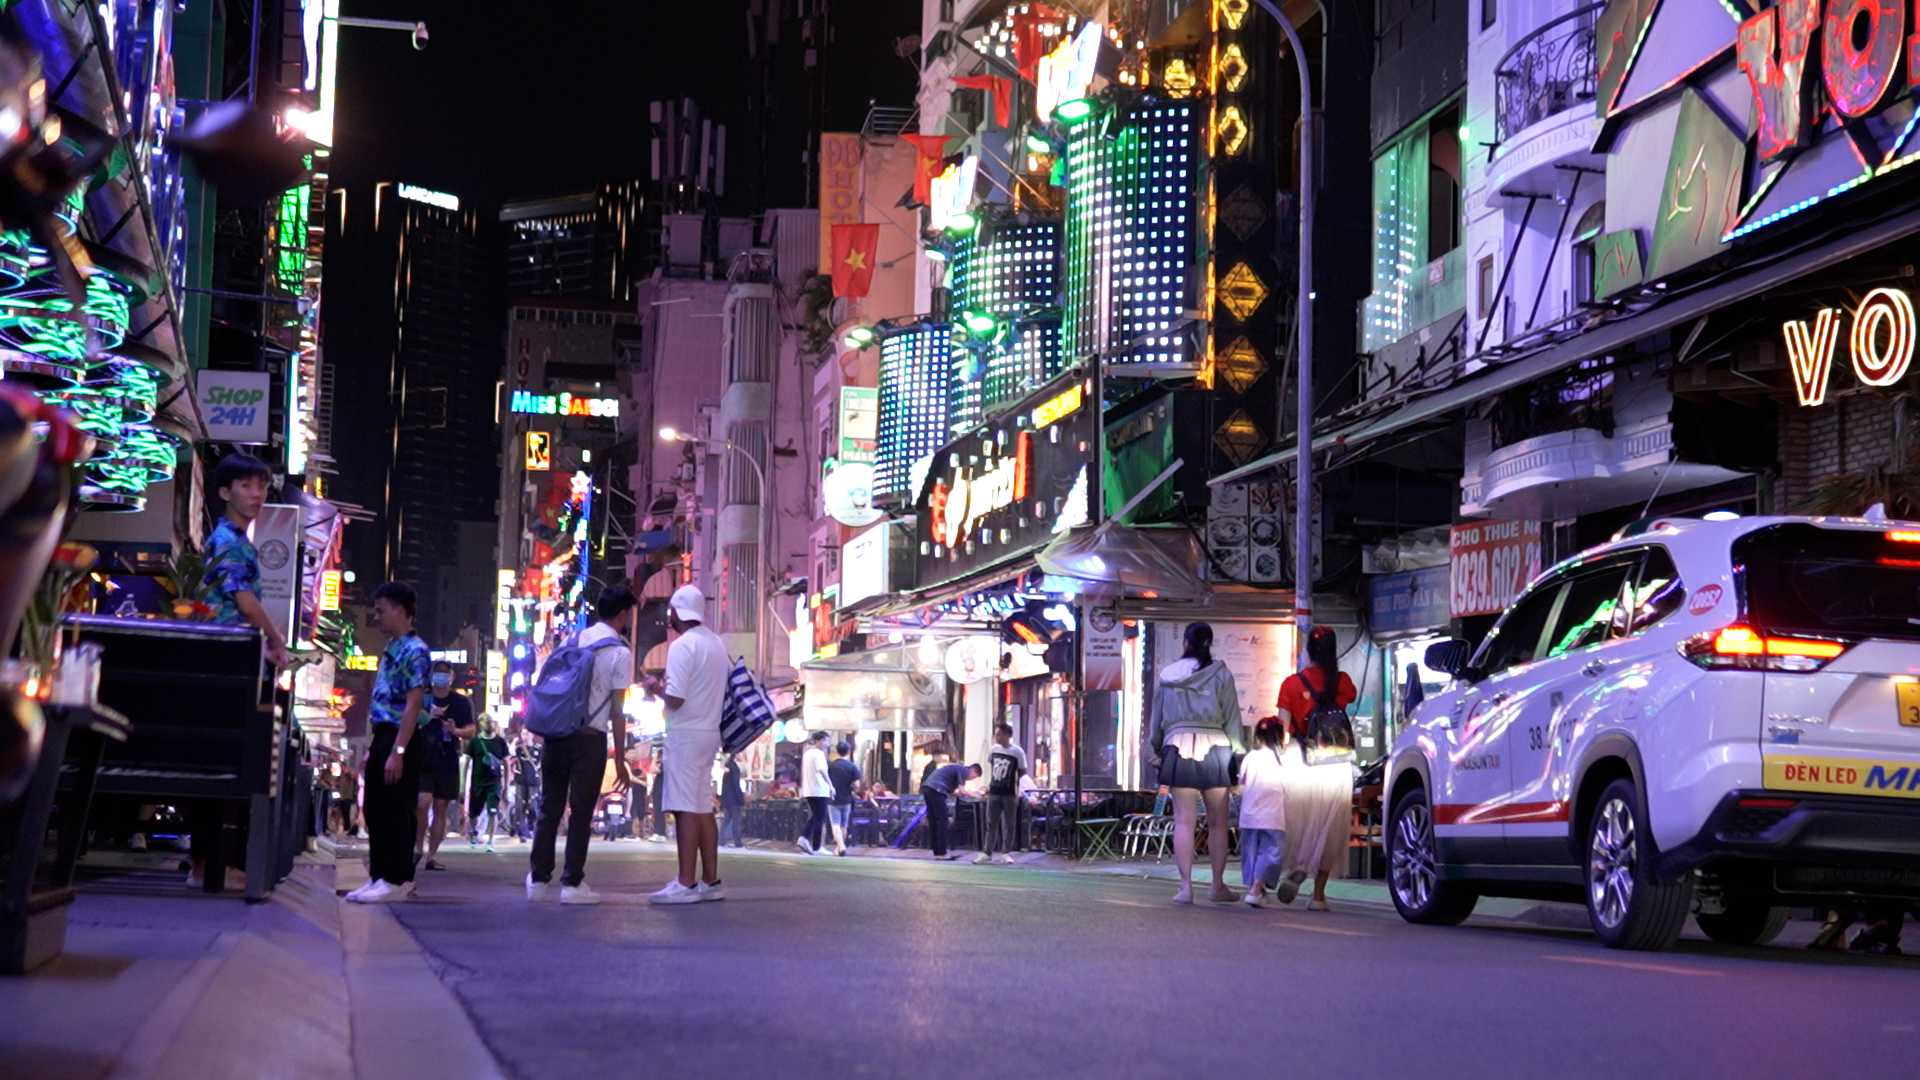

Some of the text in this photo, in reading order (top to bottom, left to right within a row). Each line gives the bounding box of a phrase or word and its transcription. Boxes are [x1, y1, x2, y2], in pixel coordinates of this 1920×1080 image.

[1737, 0, 1920, 158] VO
[824, 137, 859, 168] 96
[826, 169, 855, 229] HOT
[1783, 288, 1916, 406] VO
[203, 386, 264, 405] SHOP
[511, 391, 556, 414] MISS
[209, 406, 256, 426] 24H
[1453, 528, 1479, 548] CHO
[1450, 542, 1541, 615] 0939.6022
[1785, 761, 1820, 782] ĐÈN
[1825, 767, 1857, 784] LED
